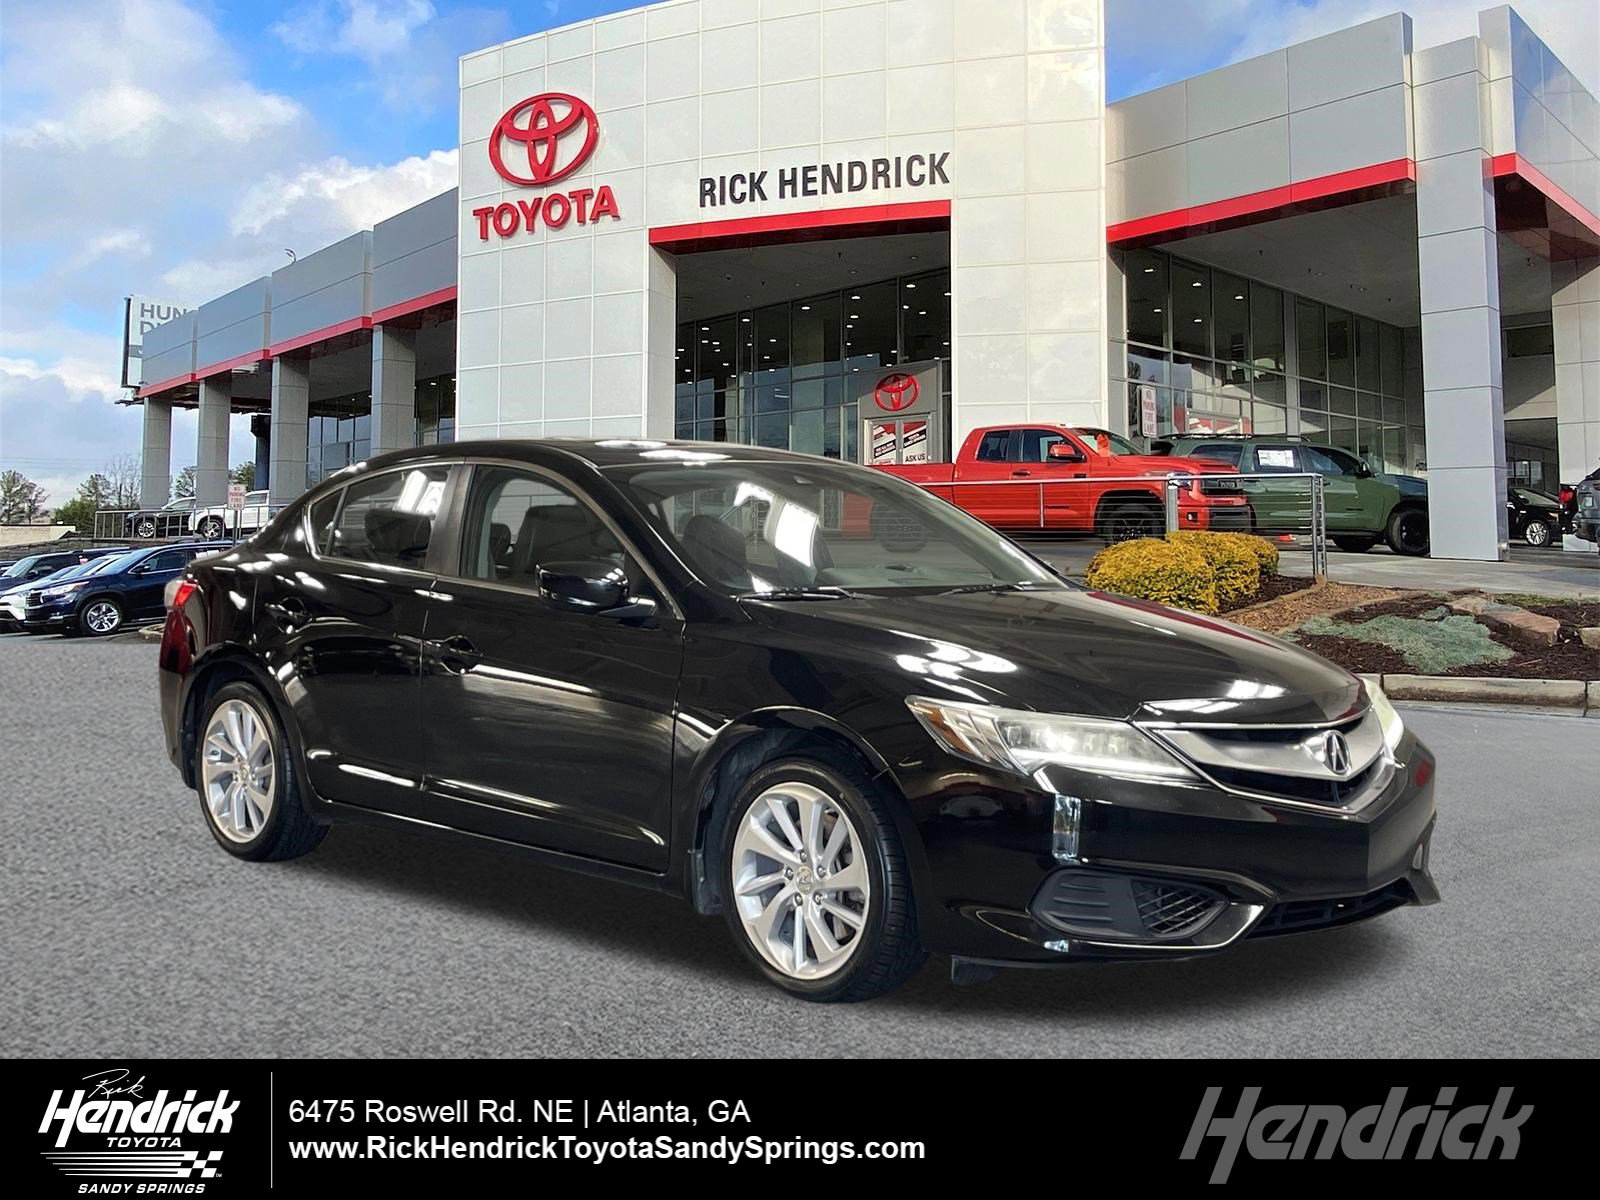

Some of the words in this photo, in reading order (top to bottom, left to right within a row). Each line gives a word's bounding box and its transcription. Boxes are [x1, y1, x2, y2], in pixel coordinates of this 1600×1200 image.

[699, 171, 768, 208] RICK
[779, 152, 951, 199] HENDRICK
[472, 185, 620, 240] TOYOTA
[904, 455, 917, 463] ASK
[917, 453, 926, 461] US
